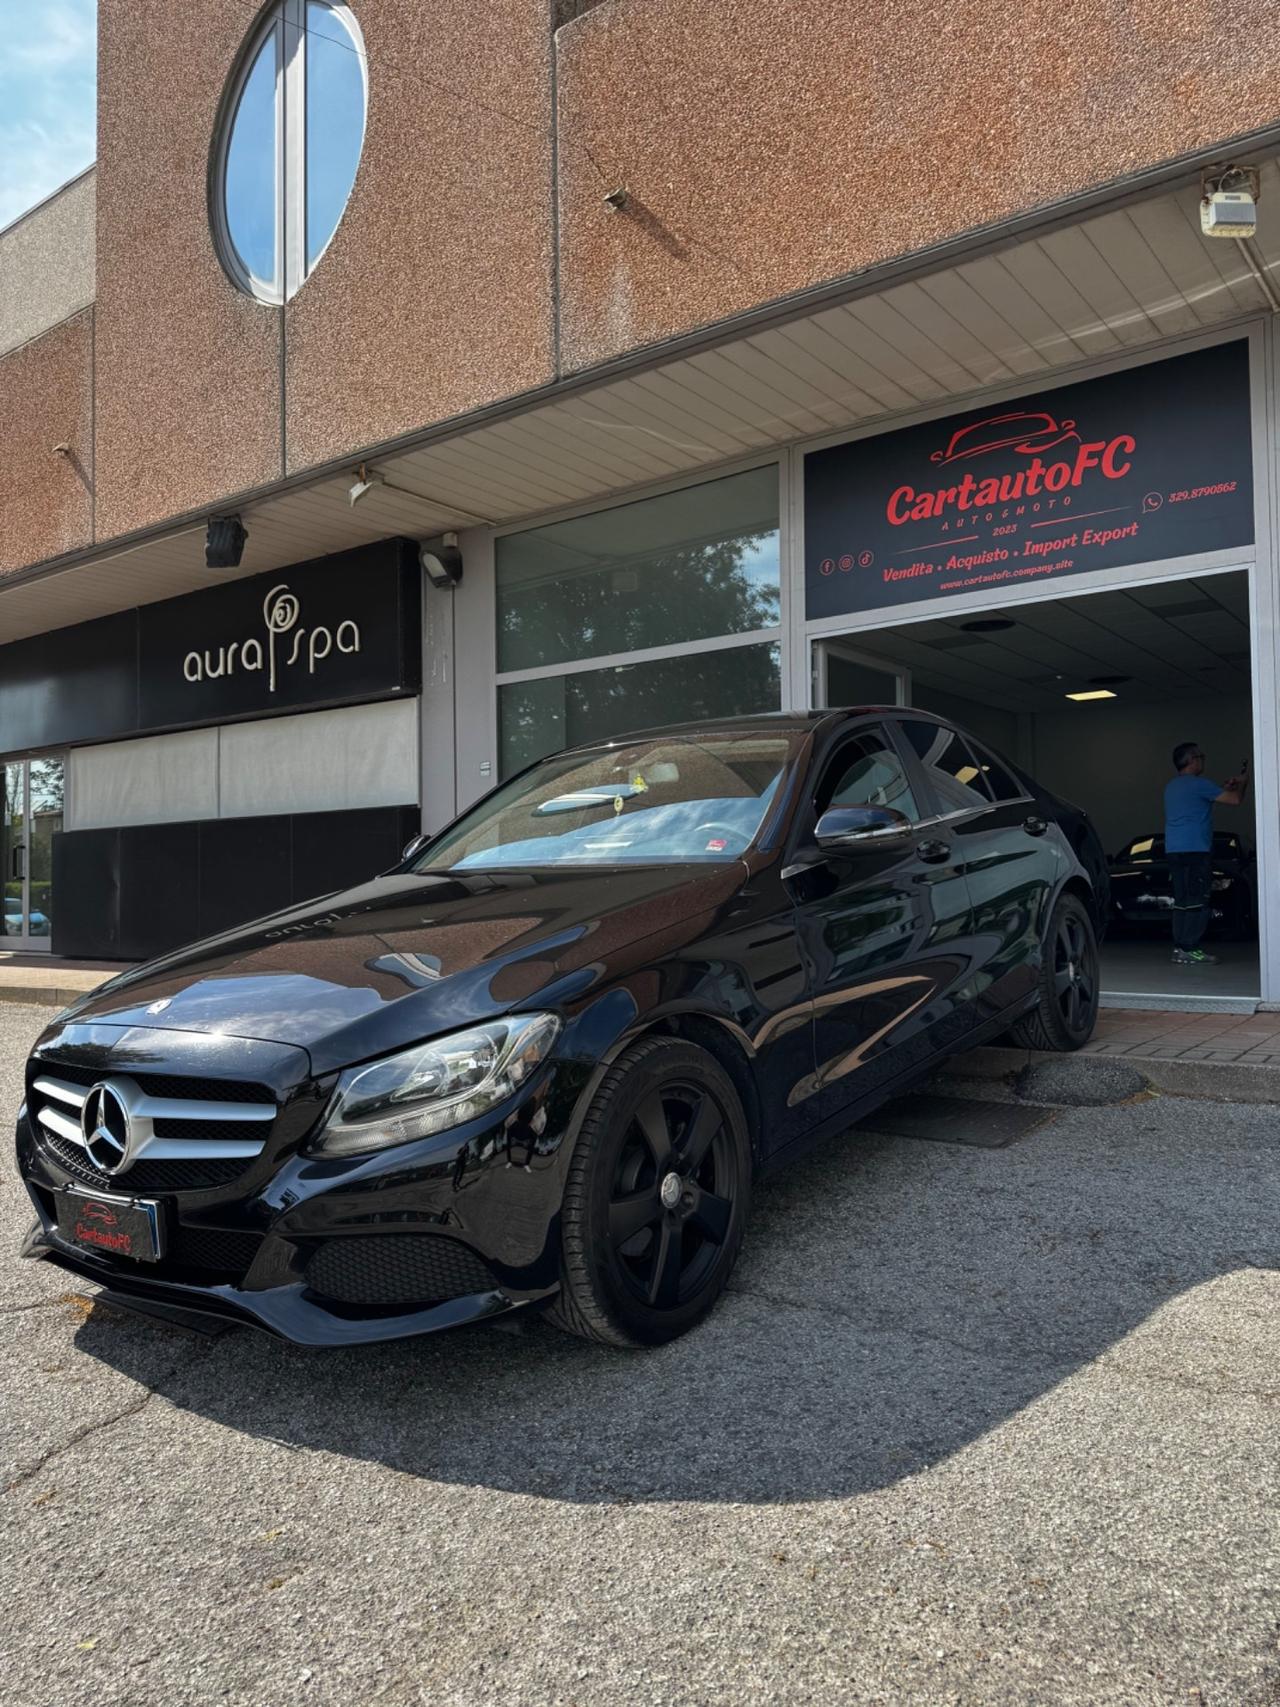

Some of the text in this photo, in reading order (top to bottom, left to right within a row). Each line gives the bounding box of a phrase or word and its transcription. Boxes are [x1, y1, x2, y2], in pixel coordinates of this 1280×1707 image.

[886, 435, 1136, 525] CartautoFC
[1168, 481, 1237, 503] 329.8790562
[992, 524, 1018, 537] 2023
[883, 522, 1139, 582] Vendita Acquisto Import Export
[939, 559, 1074, 590] www.cartautofc.company.site
[183, 620, 360, 682] aura spa
[76, 1222, 132, 1253] CartautoFC
